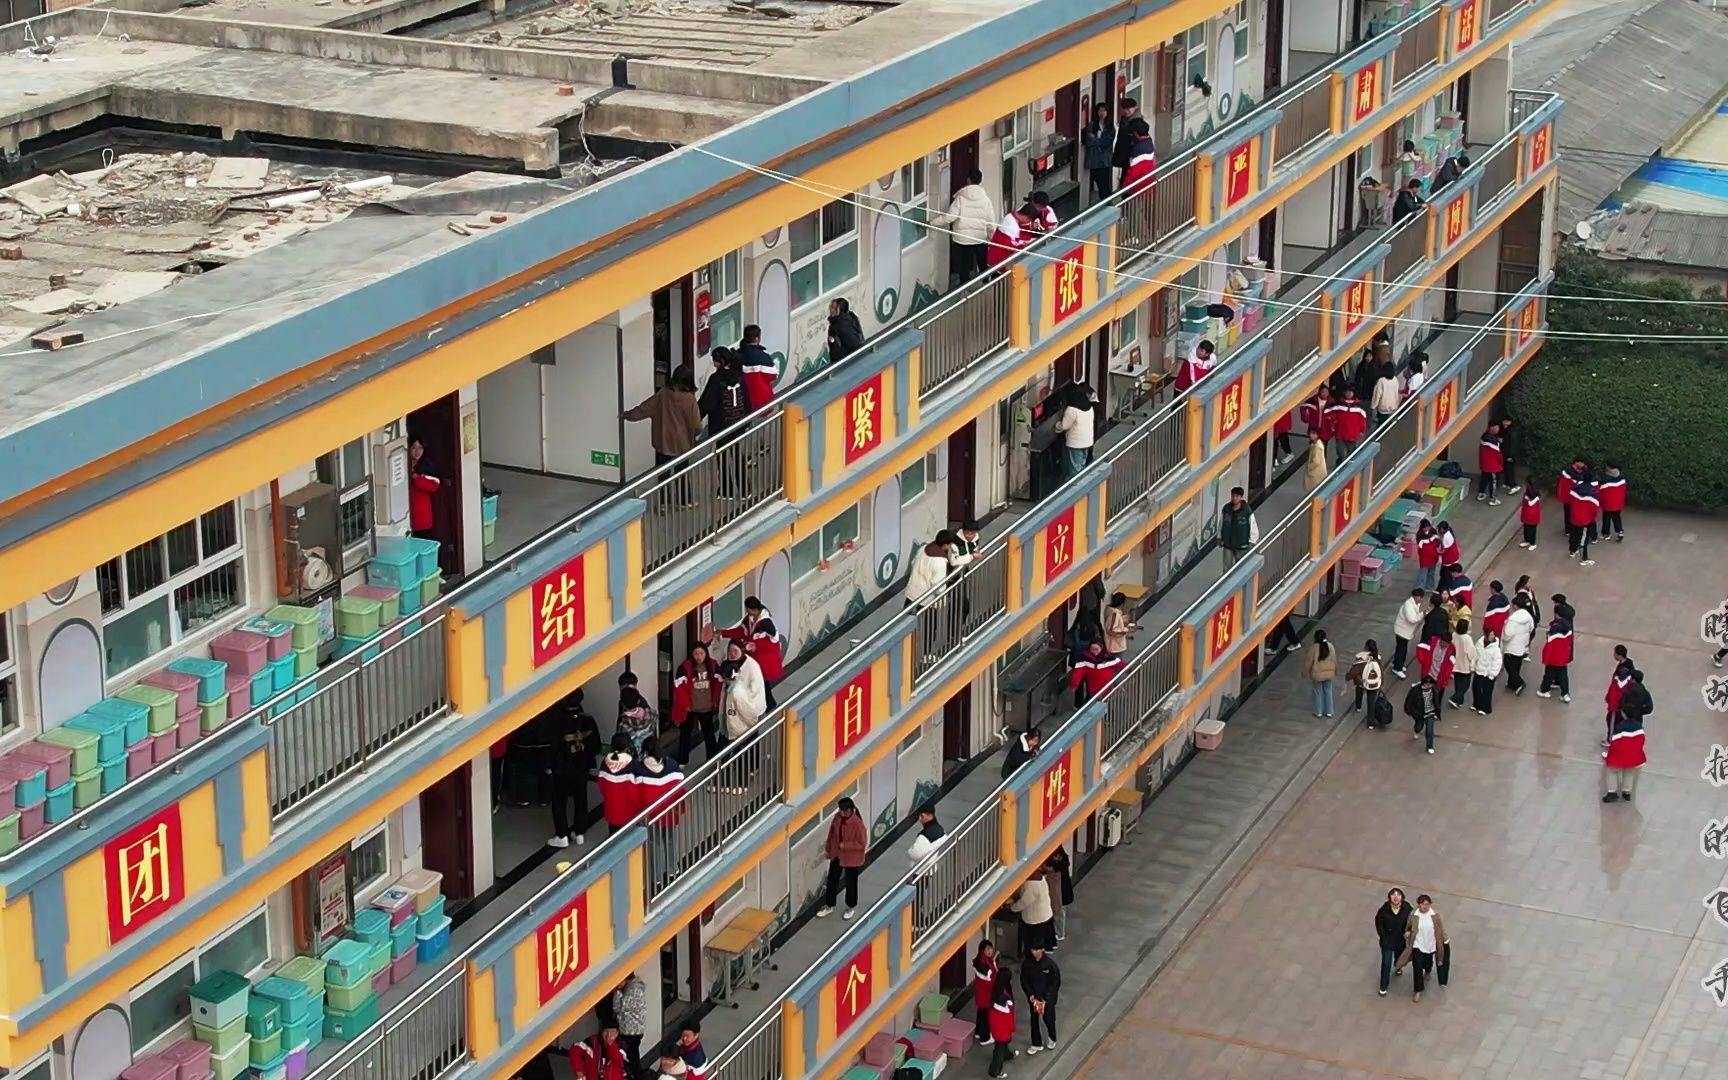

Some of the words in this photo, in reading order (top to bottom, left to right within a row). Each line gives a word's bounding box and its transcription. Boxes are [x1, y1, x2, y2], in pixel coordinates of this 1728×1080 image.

[118, 822, 170, 927] 团
[540, 572, 576, 650] 结
[852, 386, 876, 453] 紧
[1059, 257, 1079, 314] 张
[1229, 151, 1248, 200] 严
[1359, 70, 1374, 113] 肃
[1460, 5, 1474, 43] 活
[546, 908, 579, 988] 明
[843, 684, 863, 746] 自
[1050, 523, 1071, 575] 立
[1222, 382, 1239, 432] 感
[841, 964, 867, 1016] 个
[1046, 762, 1067, 818] 性
